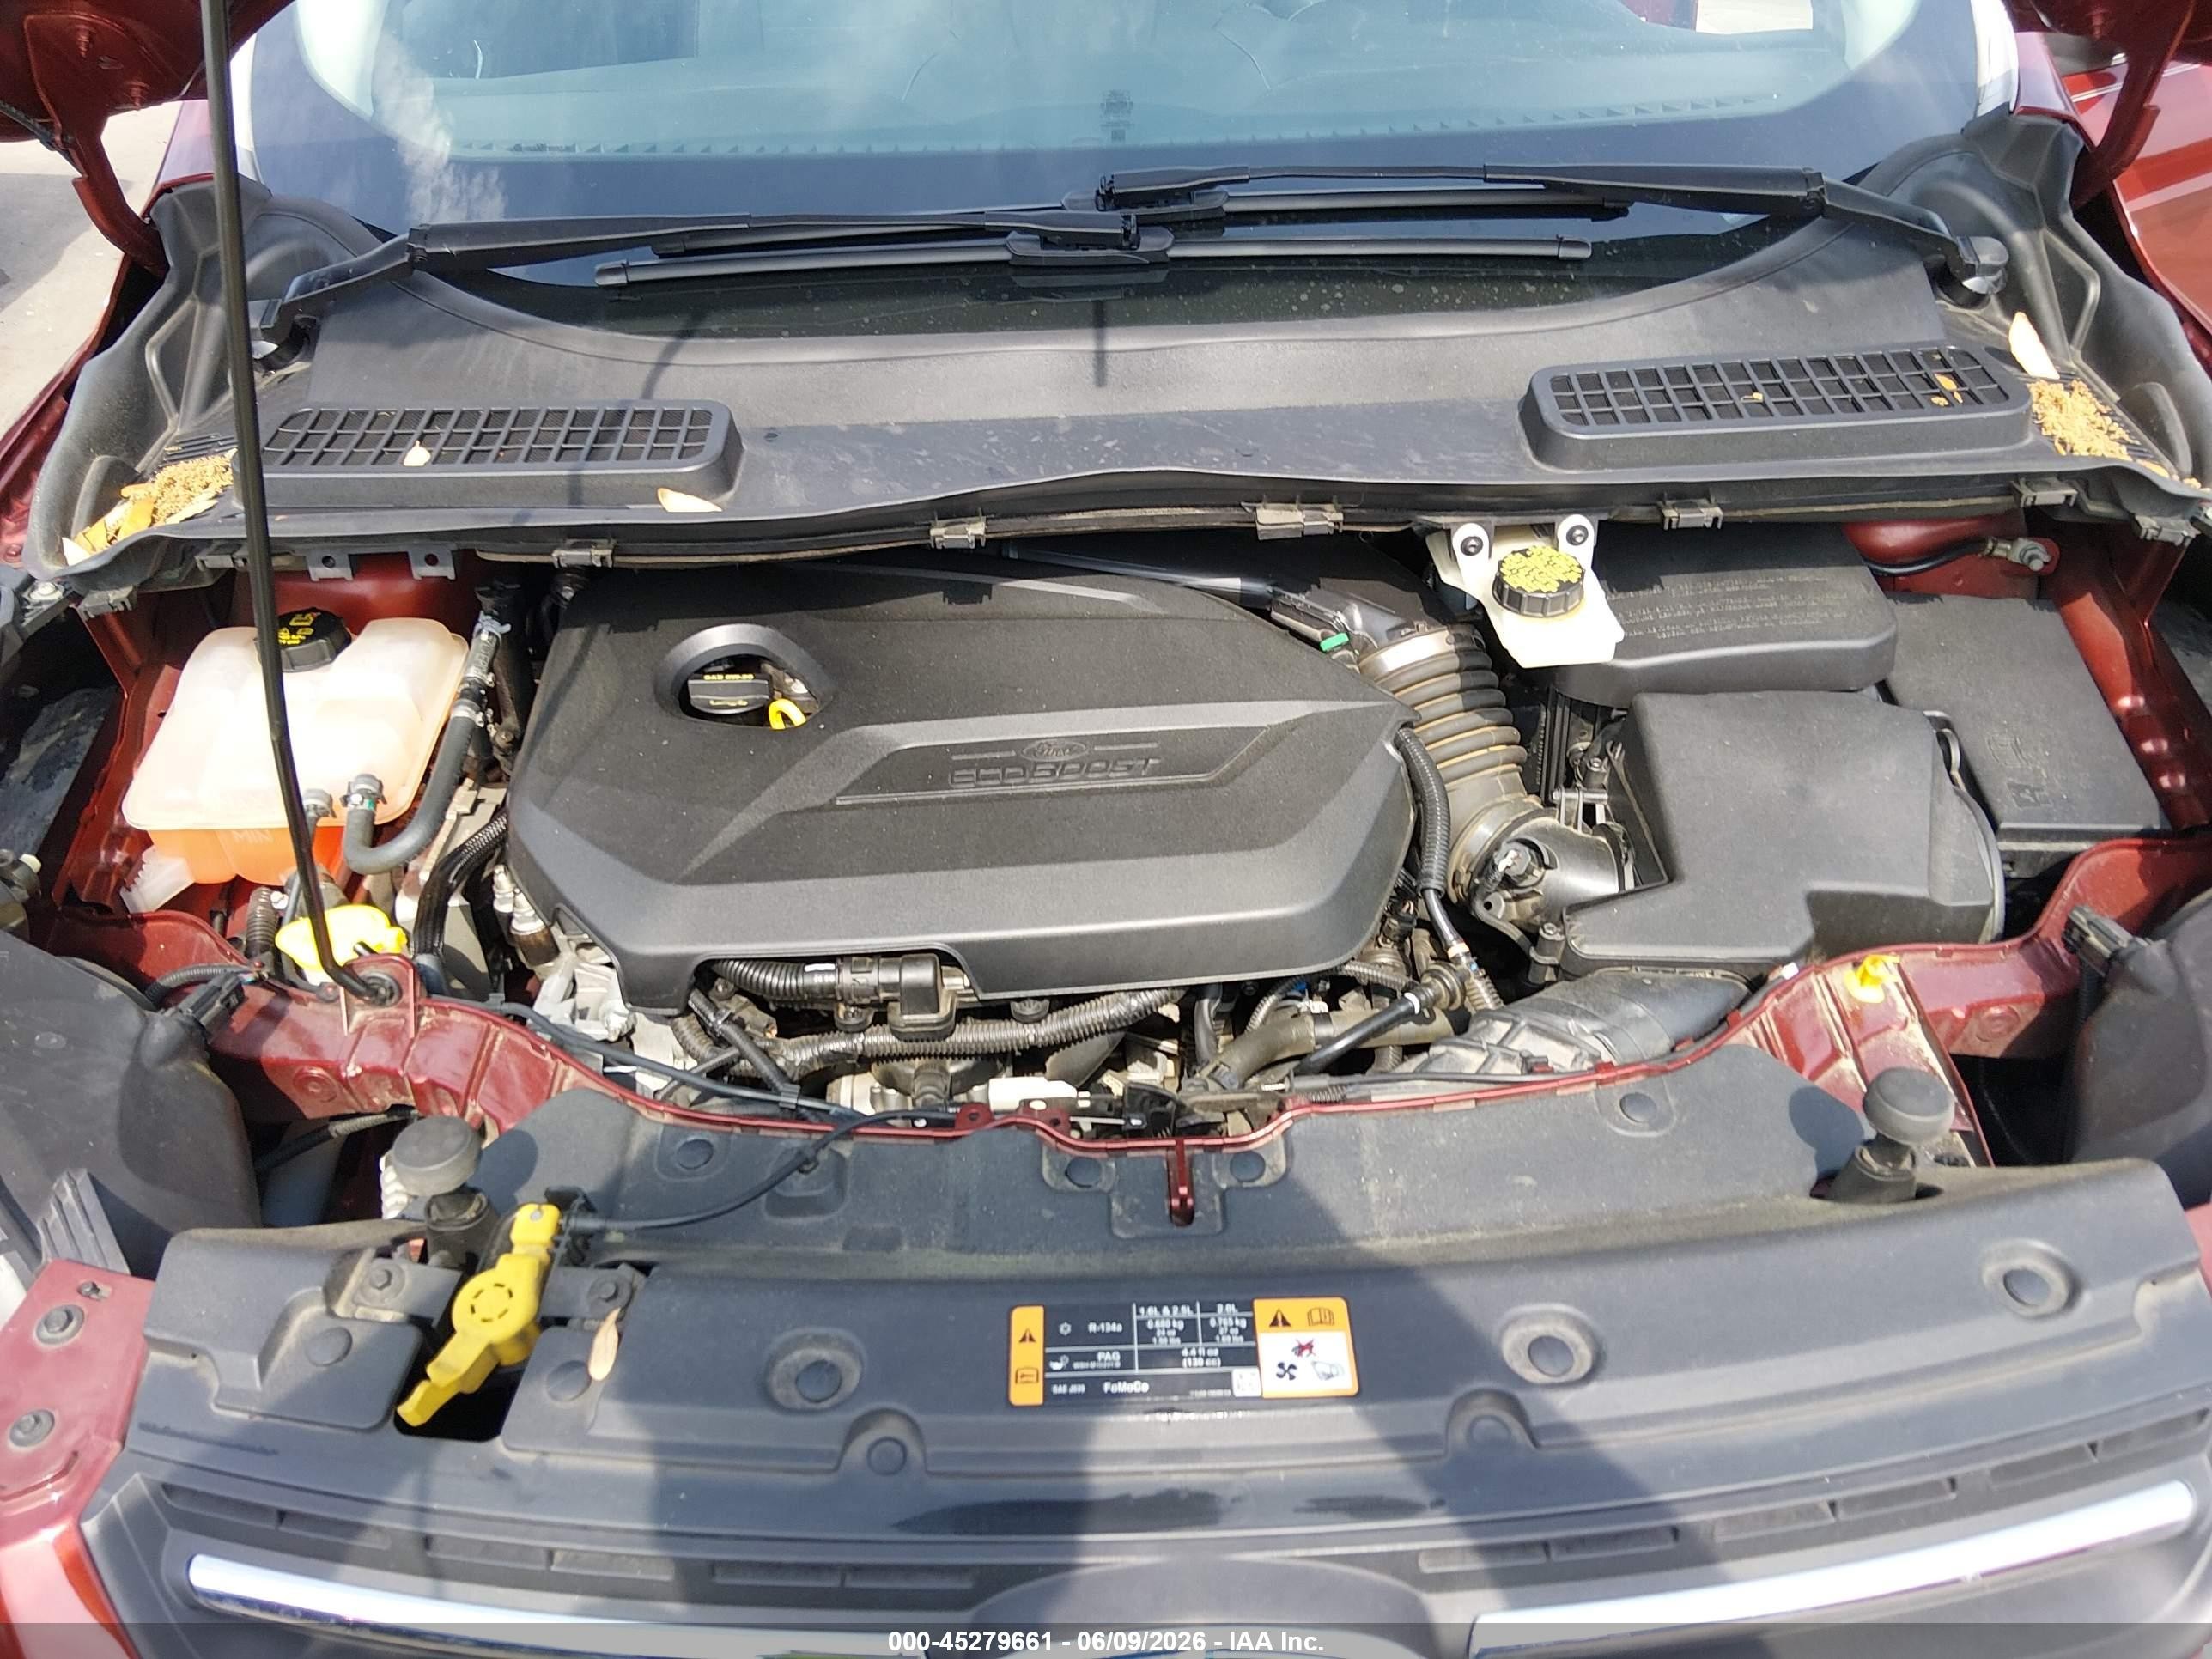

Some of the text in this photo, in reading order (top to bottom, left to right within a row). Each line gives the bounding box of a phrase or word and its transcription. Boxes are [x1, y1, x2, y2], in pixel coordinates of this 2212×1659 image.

[231, 830, 275, 844] MIN
[1088, 1322, 1123, 1334] R-134a
[1097, 1351, 1121, 1362] PAG
[1102, 1381, 1151, 1394] FoMoCo
